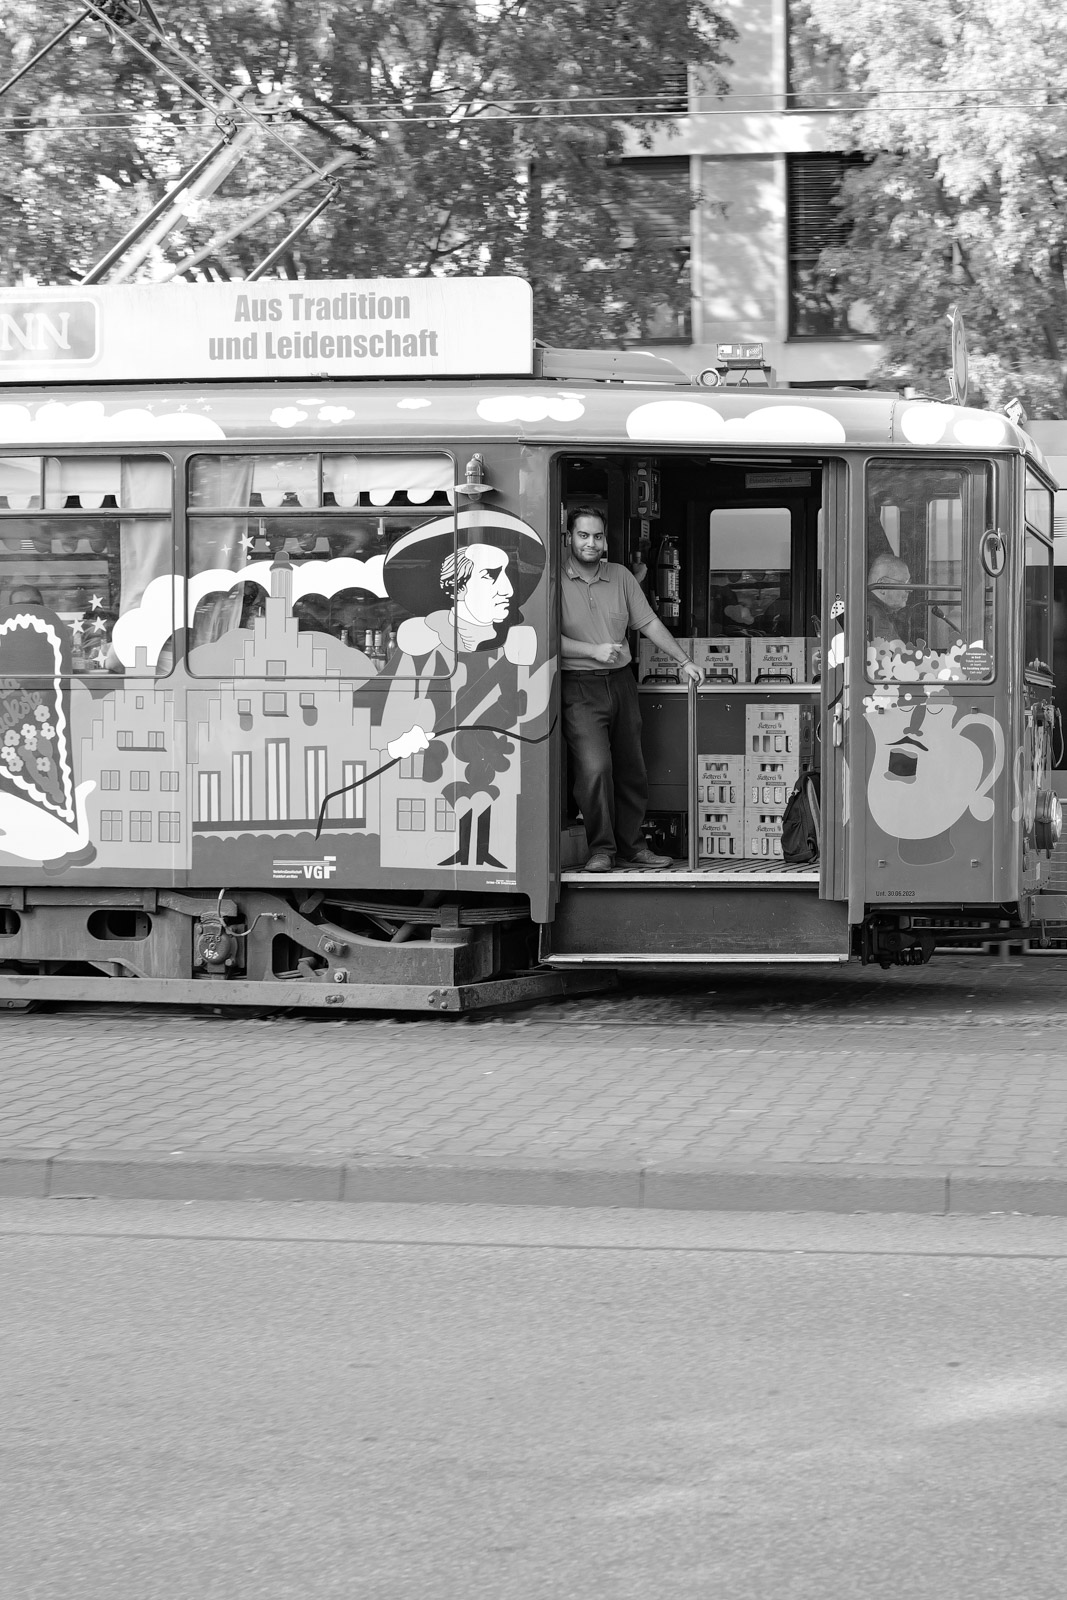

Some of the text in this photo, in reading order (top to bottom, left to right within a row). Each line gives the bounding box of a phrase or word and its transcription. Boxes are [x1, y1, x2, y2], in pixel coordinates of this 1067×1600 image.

[234, 291, 410, 322] Aus Tradition
[209, 329, 438, 361] und Leidenschaft
[303, 856, 337, 879] VGF
